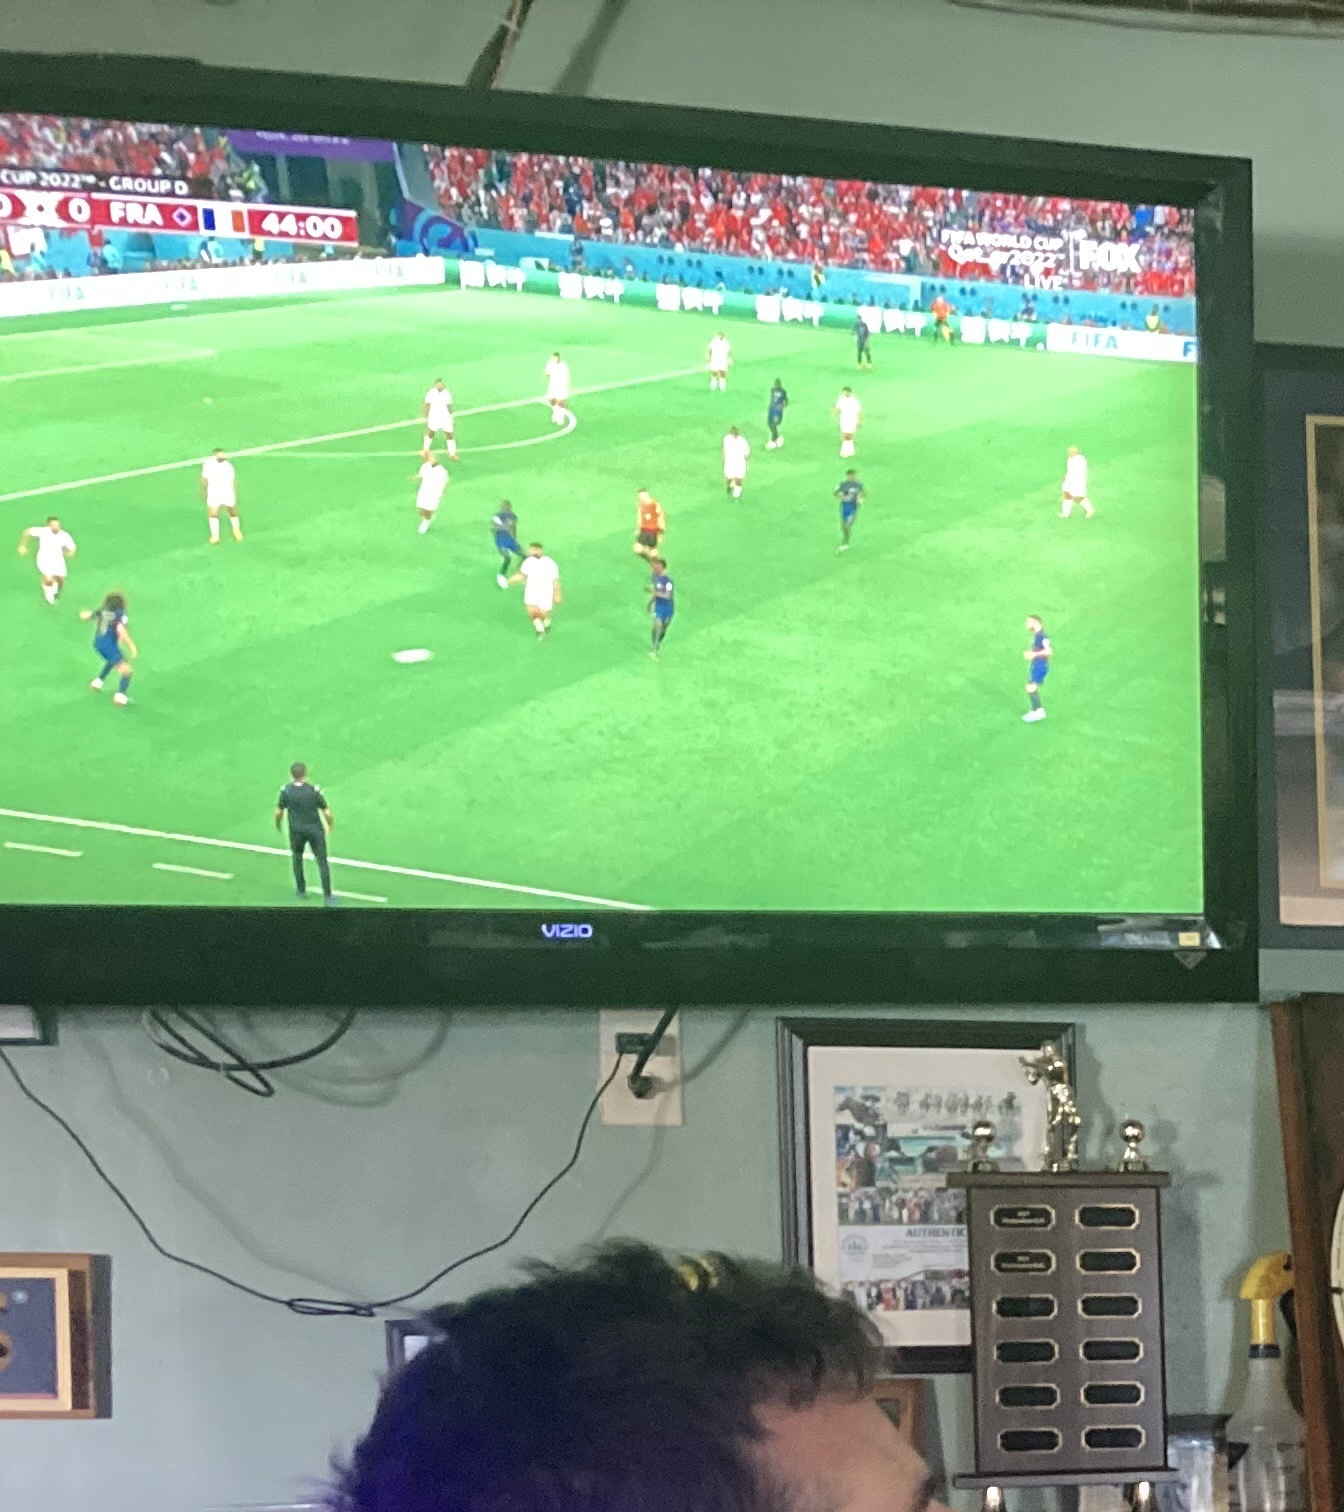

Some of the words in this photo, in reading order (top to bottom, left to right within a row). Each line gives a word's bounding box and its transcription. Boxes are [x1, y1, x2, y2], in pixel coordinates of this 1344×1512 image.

[109, 175, 171, 193] GROUP
[174, 179, 189, 195] D
[109, 201, 165, 227] FRA
[261, 211, 344, 240] 44:00
[1079, 240, 1142, 274] FOX
[1024, 275, 1064, 291] LIVE
[541, 923, 594, 939] VIZIO
